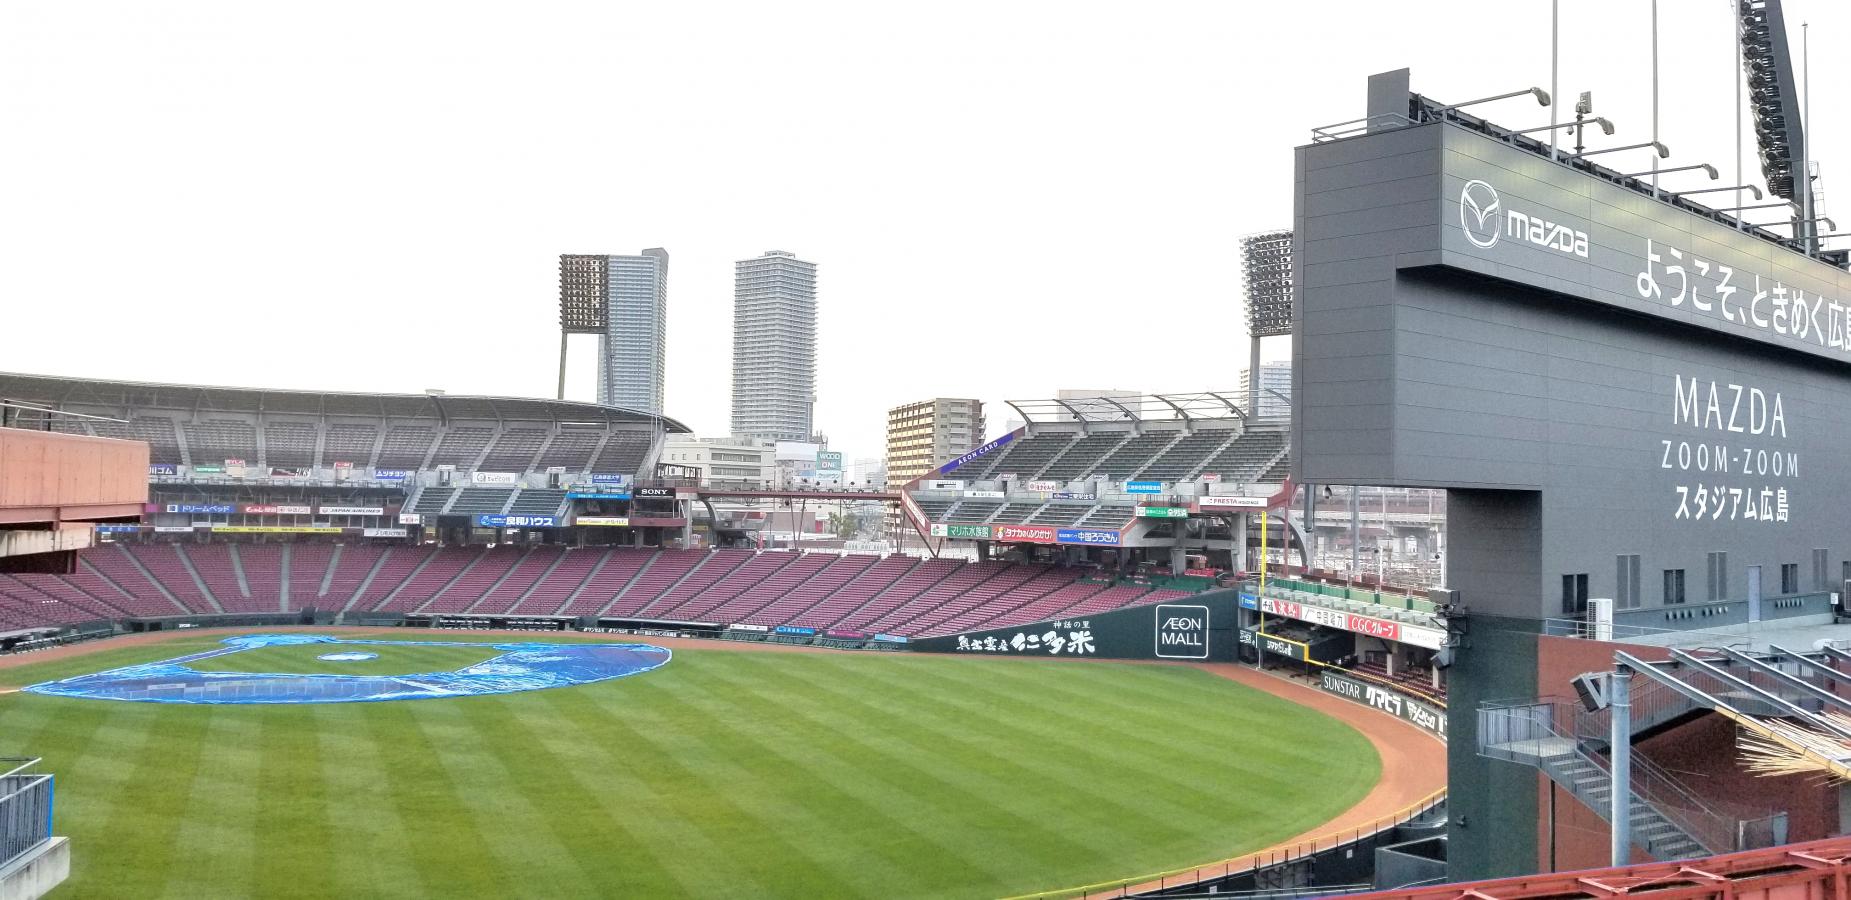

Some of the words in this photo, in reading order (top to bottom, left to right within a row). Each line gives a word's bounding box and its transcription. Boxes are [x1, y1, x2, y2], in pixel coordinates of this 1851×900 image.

[1674, 374, 1787, 438] MAZDA
[819, 452, 841, 460] WOOD
[979, 441, 998, 454] CARD
[1661, 440, 1798, 478] ZOOM-ZOOM
[1675, 483, 1789, 523] スタジアム広島
[951, 526, 989, 538] マリホ水族館
[1078, 531, 1118, 543] 中国ろうきん
[1053, 620, 1091, 629] 神話の里
[1351, 616, 1394, 637] CGCグループ
[1010, 630, 1095, 654] 仁多米
[1162, 632, 1202, 646] MALL
[1324, 676, 1360, 699] SUNSTAR
[1365, 686, 1401, 716] クマヒラ
